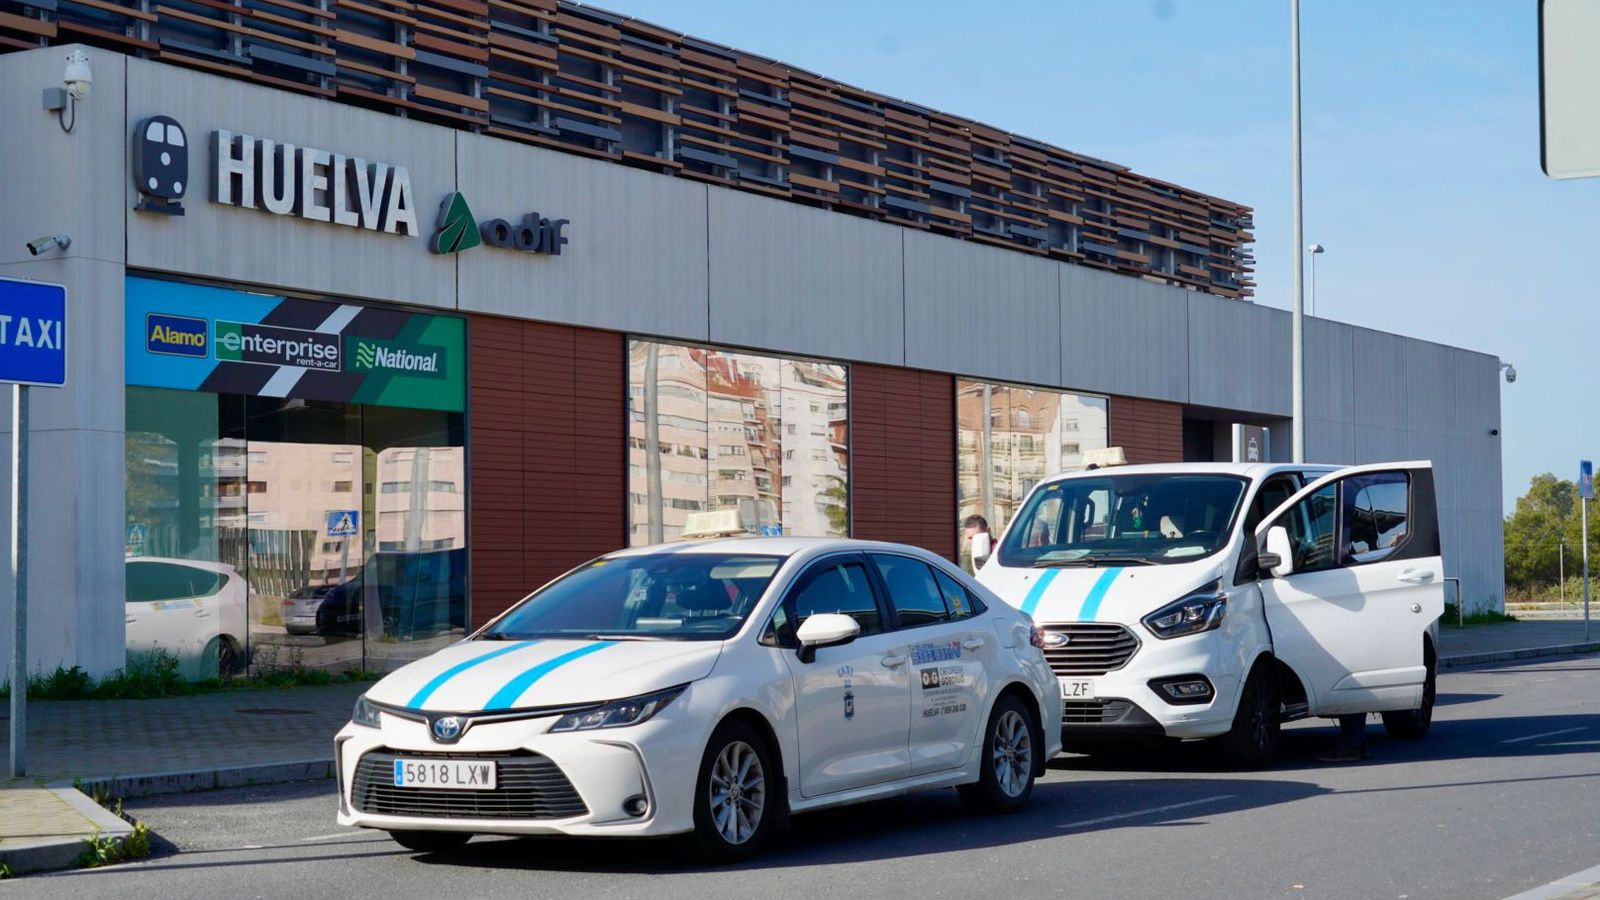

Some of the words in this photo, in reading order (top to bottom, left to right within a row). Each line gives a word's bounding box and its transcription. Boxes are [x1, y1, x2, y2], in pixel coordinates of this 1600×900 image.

[212, 128, 420, 238] HUELVA
[482, 212, 570, 256] adif
[0, 314, 62, 350] TAXI
[151, 325, 205, 347] Alamo
[217, 331, 338, 361] enterprise
[375, 346, 437, 372] National
[296, 357, 337, 369] rent-a-car
[1062, 682, 1089, 697] LZF
[406, 763, 450, 784] 5818
[456, 764, 490, 785] LXW
